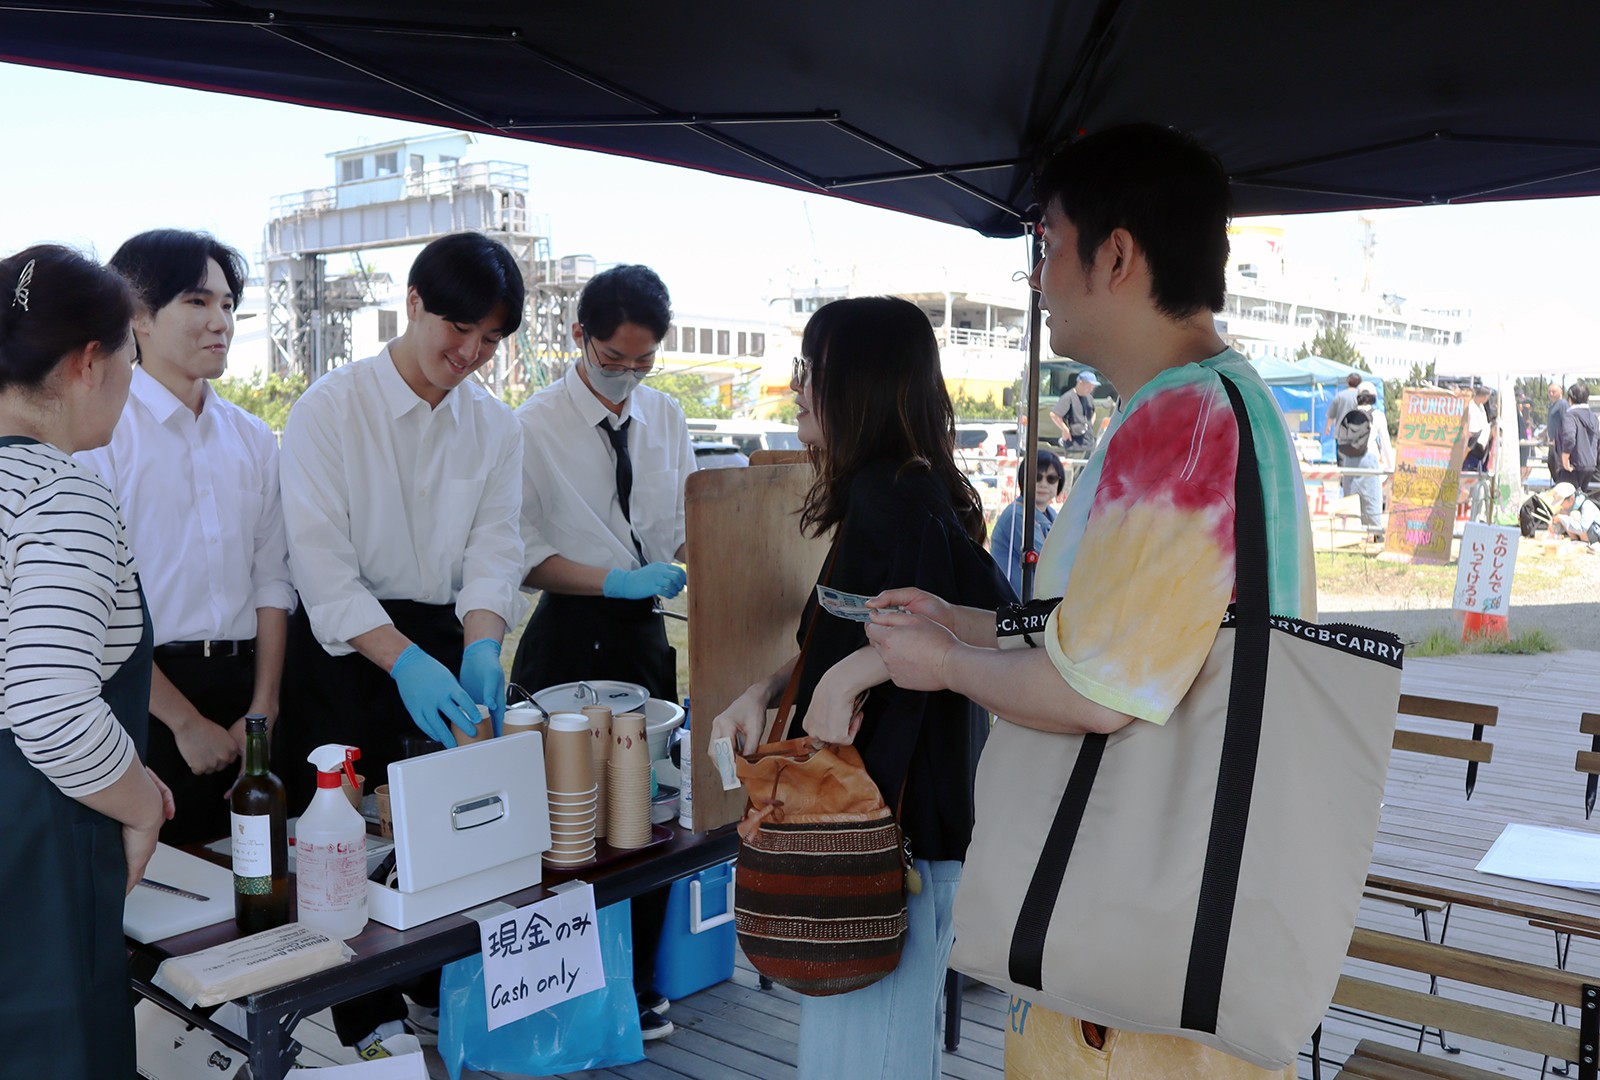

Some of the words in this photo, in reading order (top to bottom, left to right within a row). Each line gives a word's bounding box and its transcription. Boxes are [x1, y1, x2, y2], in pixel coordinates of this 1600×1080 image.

[1408, 394, 1465, 417] RUNRUN
[1489, 533, 1508, 593] たのしんで
[286, 936, 330, 953] Reusable
[488, 912, 592, 958] 現金のみ
[246, 949, 287, 966] Bamboo
[491, 976, 529, 1010] Cash
[537, 957, 581, 994] only
